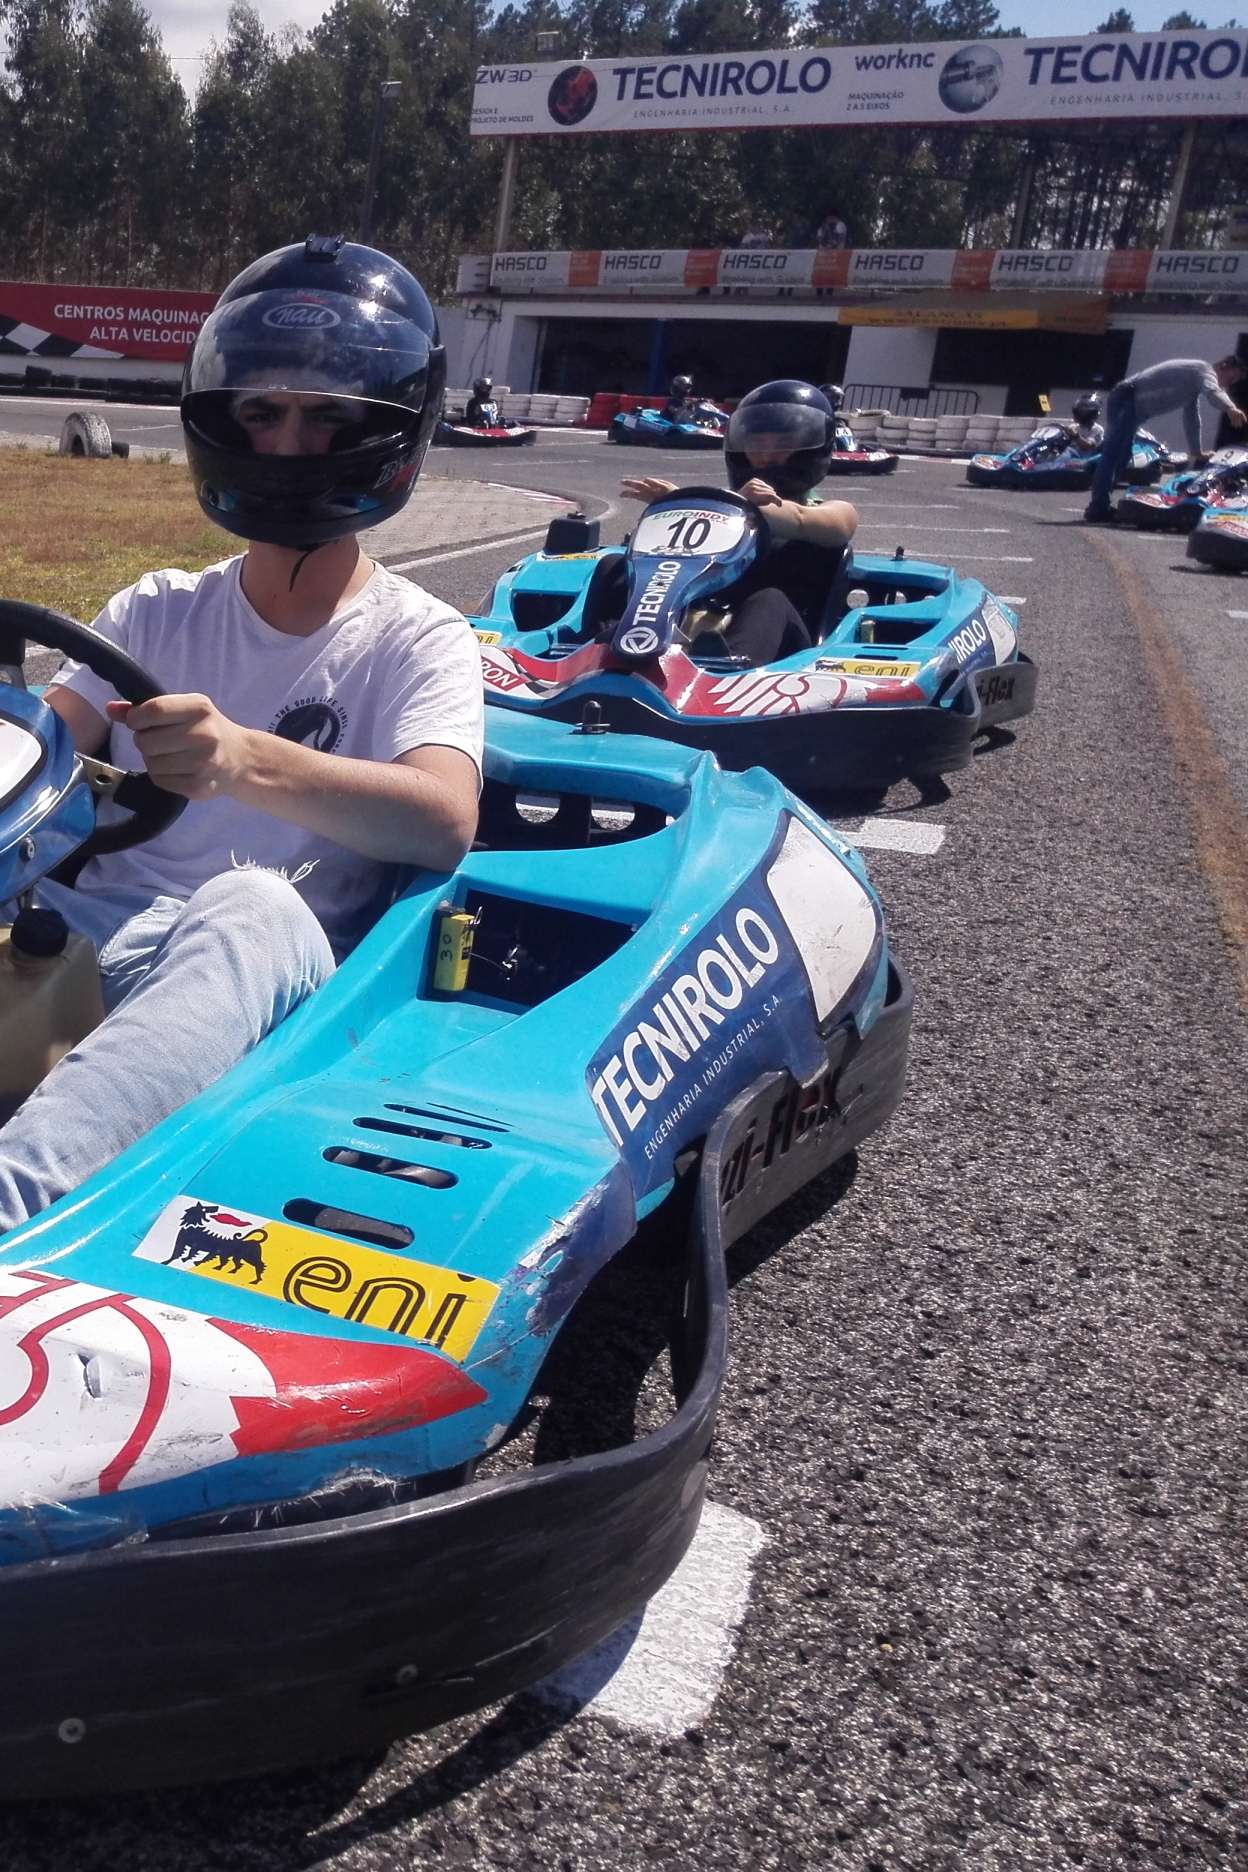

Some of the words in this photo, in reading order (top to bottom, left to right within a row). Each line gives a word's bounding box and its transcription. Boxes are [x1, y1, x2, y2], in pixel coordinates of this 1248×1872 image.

[855, 49, 935, 71] worknc
[613, 57, 832, 100] TECNIROLO
[495, 256, 547, 271] HASCO
[604, 255, 662, 270] HASCO
[723, 254, 788, 269] HASCO
[855, 255, 924, 271] HASCO
[998, 255, 1073, 272] HASCO
[1156, 255, 1240, 273] HASCO
[54, 304, 124, 320] CENTROS
[90, 326, 128, 341] ALTA
[666, 517, 712, 550] 10
[854, 663, 911, 677] eni
[591, 907, 780, 1147] TECNIROLO
[644, 1084, 703, 1160] ENGENHARIA
[282, 1255, 479, 1351] eni
